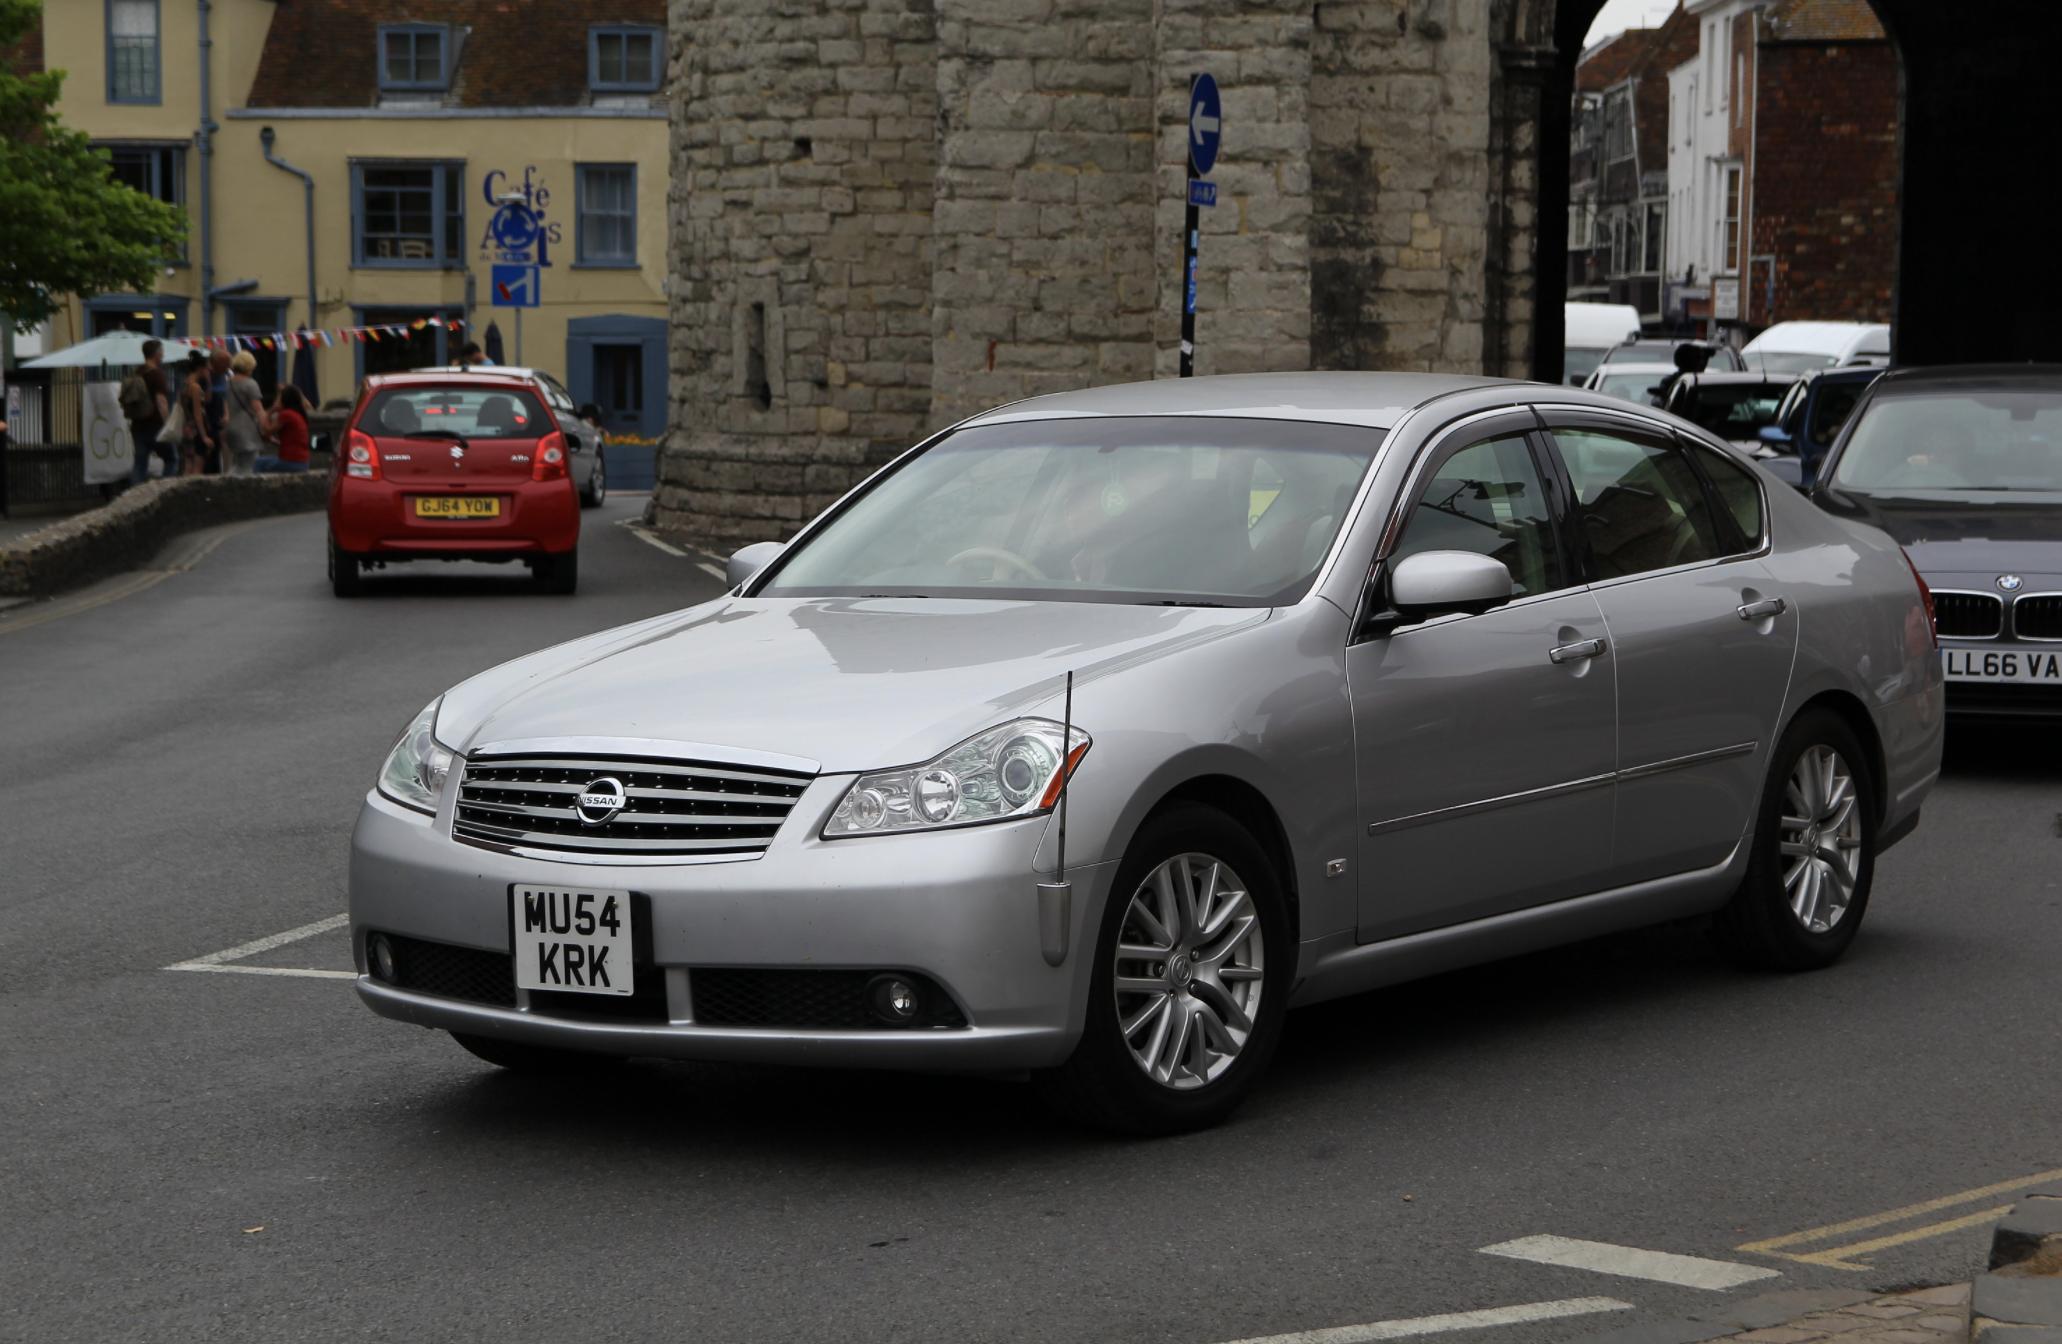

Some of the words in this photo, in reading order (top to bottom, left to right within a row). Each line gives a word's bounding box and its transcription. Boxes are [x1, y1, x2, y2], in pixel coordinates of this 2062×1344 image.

[483, 165, 550, 208] Cfé
[480, 209, 562, 267] Ais
[421, 500, 460, 513] GJ64
[464, 500, 493, 512] YOW
[1947, 652, 2017, 676] LL66
[2027, 653, 2060, 679] VA
[578, 796, 618, 806] NISSAN
[524, 891, 621, 938] MU54
[538, 942, 611, 988] KRK
